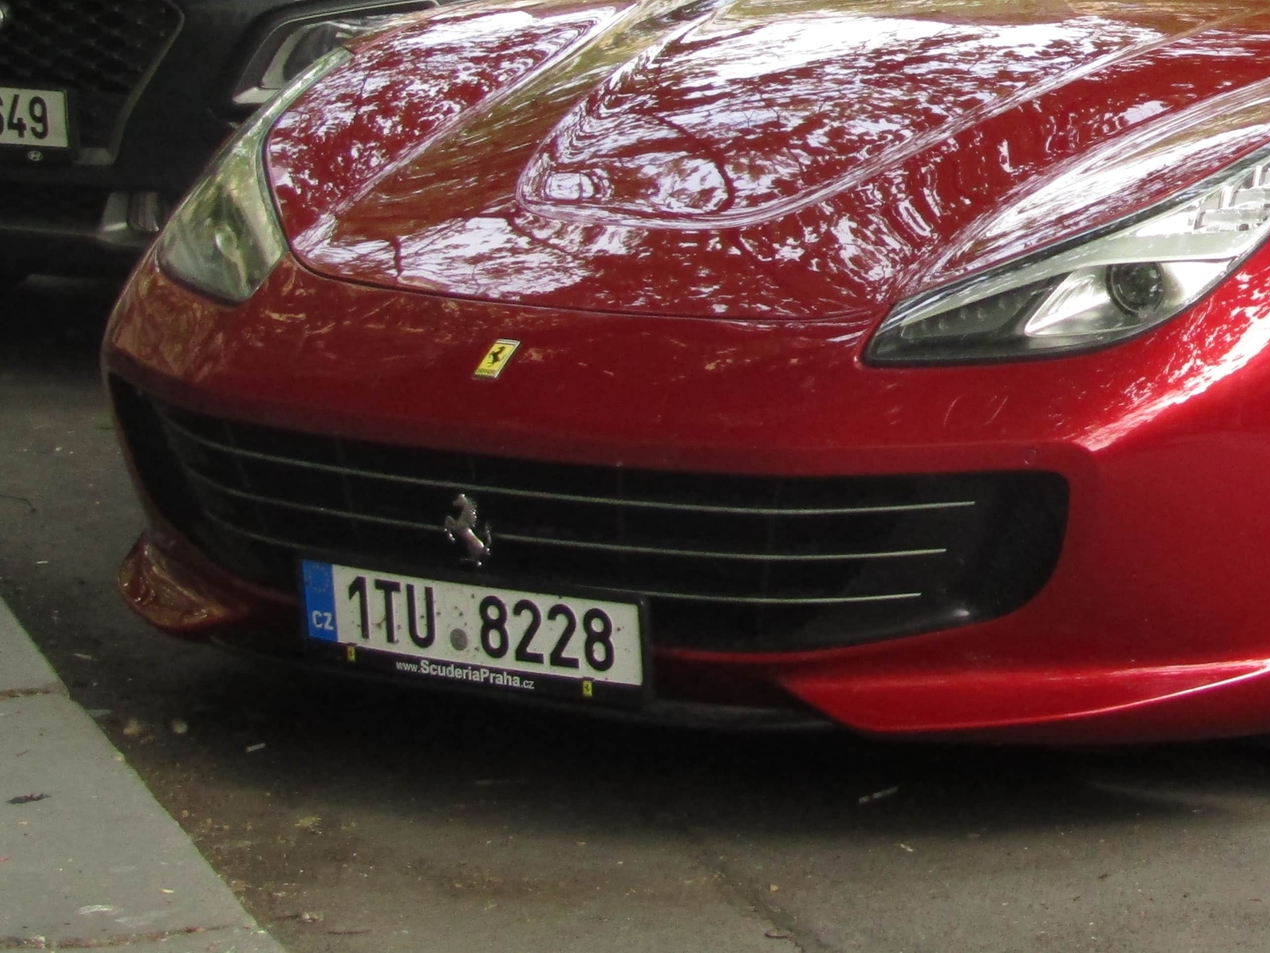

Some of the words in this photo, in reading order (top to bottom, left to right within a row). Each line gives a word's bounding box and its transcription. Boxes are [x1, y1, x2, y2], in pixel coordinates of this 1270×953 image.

[0, 94, 50, 140] 49
[312, 610, 334, 631] CZ
[348, 576, 436, 648] 1TU
[479, 595, 615, 672] 8228
[395, 659, 535, 690] www.ScuderiaPraha.cz
